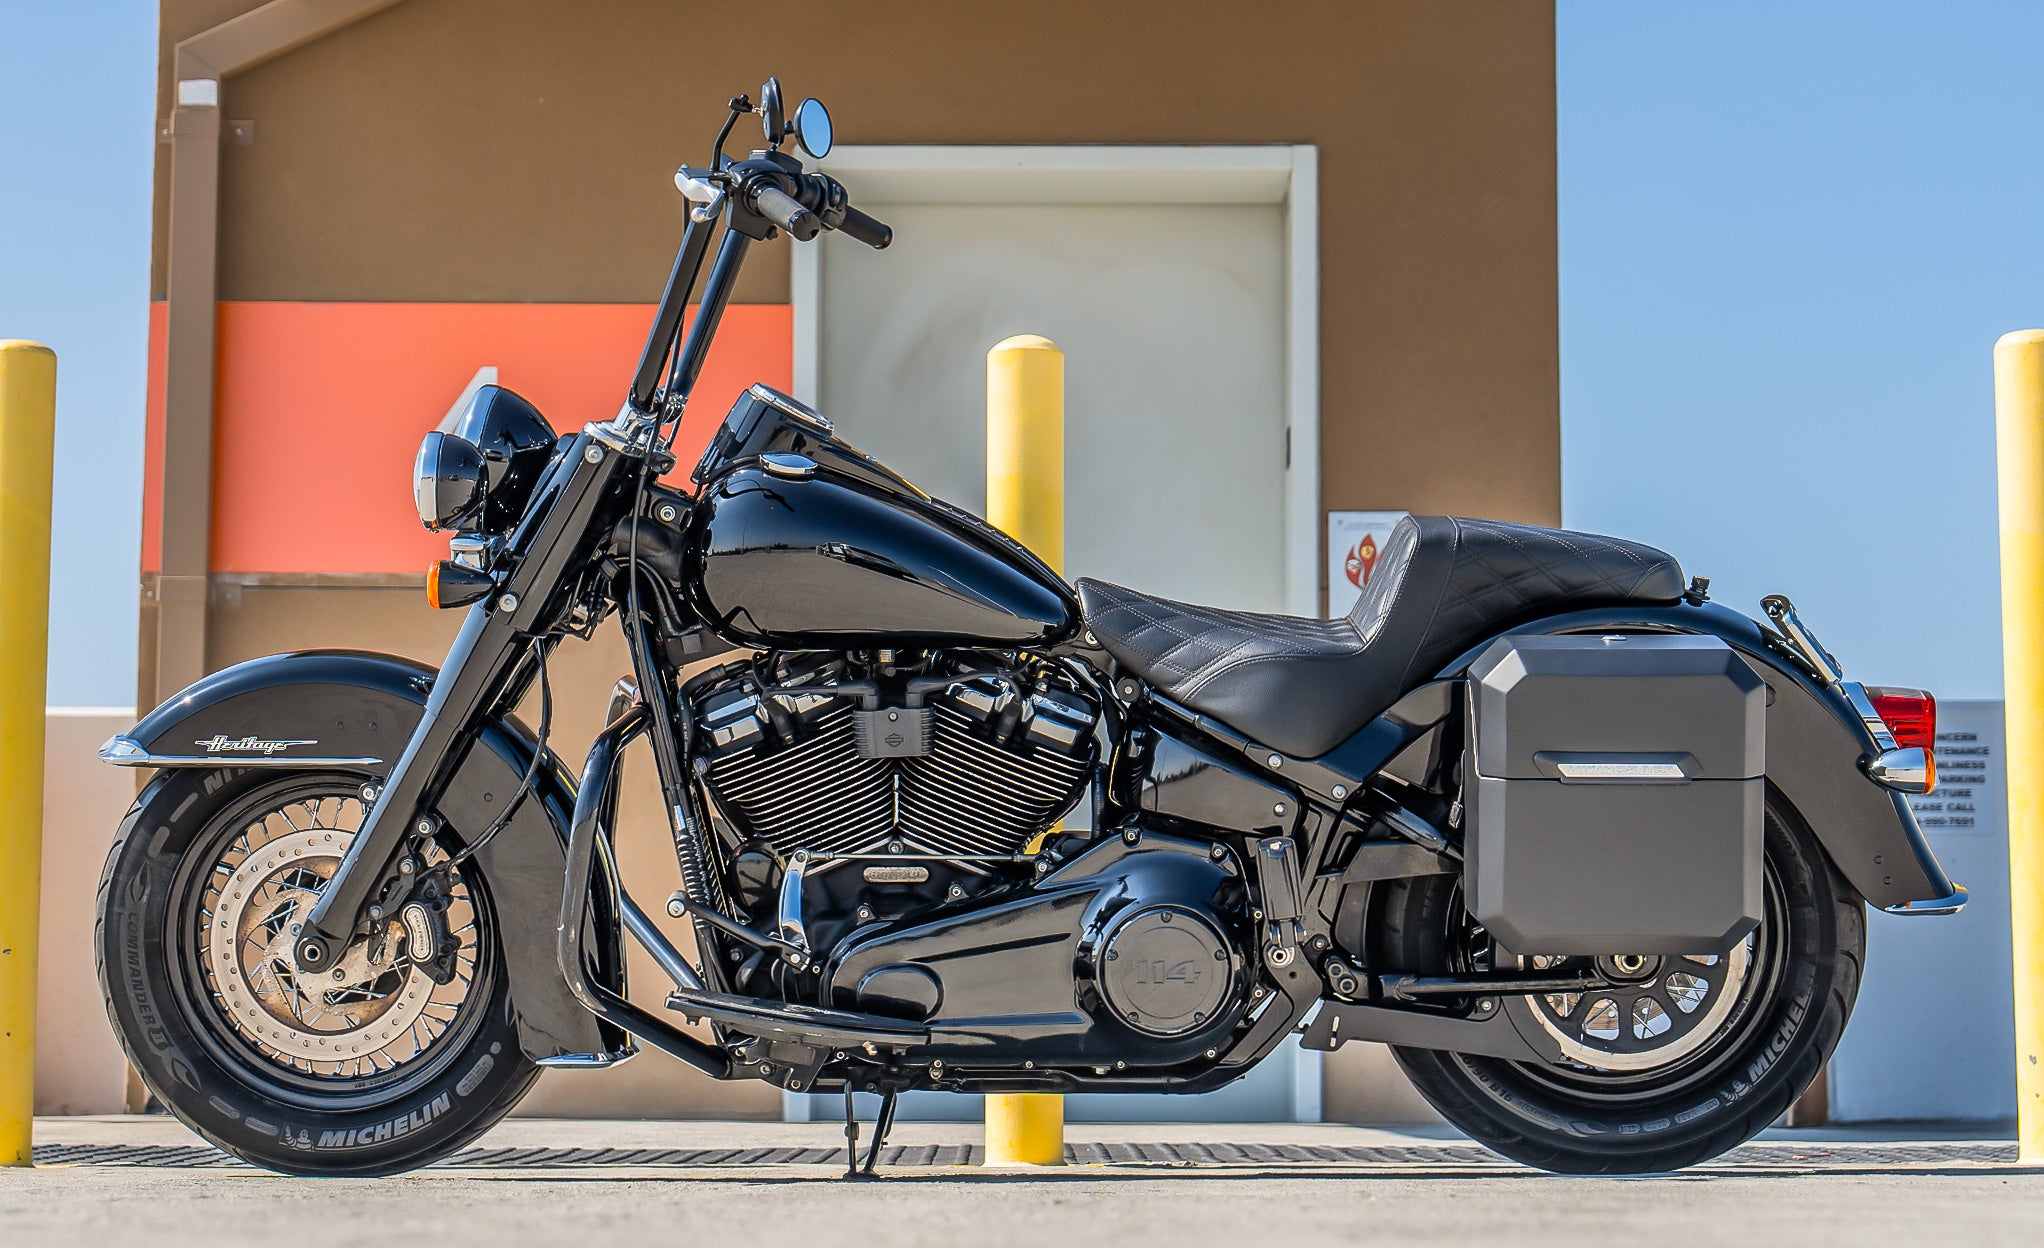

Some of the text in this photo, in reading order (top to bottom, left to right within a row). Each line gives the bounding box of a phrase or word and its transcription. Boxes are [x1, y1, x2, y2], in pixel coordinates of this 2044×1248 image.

[1937, 732, 1977, 741] NCERN
[206, 734, 287, 755] Heritage
[1934, 746, 1990, 755] TENANCE
[1940, 775, 1986, 783] ARKING
[1933, 788, 1972, 797] CTURE
[1914, 803, 1975, 812] EASE CALL
[1135, 959, 1201, 984] 114
[1747, 980, 1812, 1083] MICHEL
[317, 1091, 451, 1147] MICHELIN
